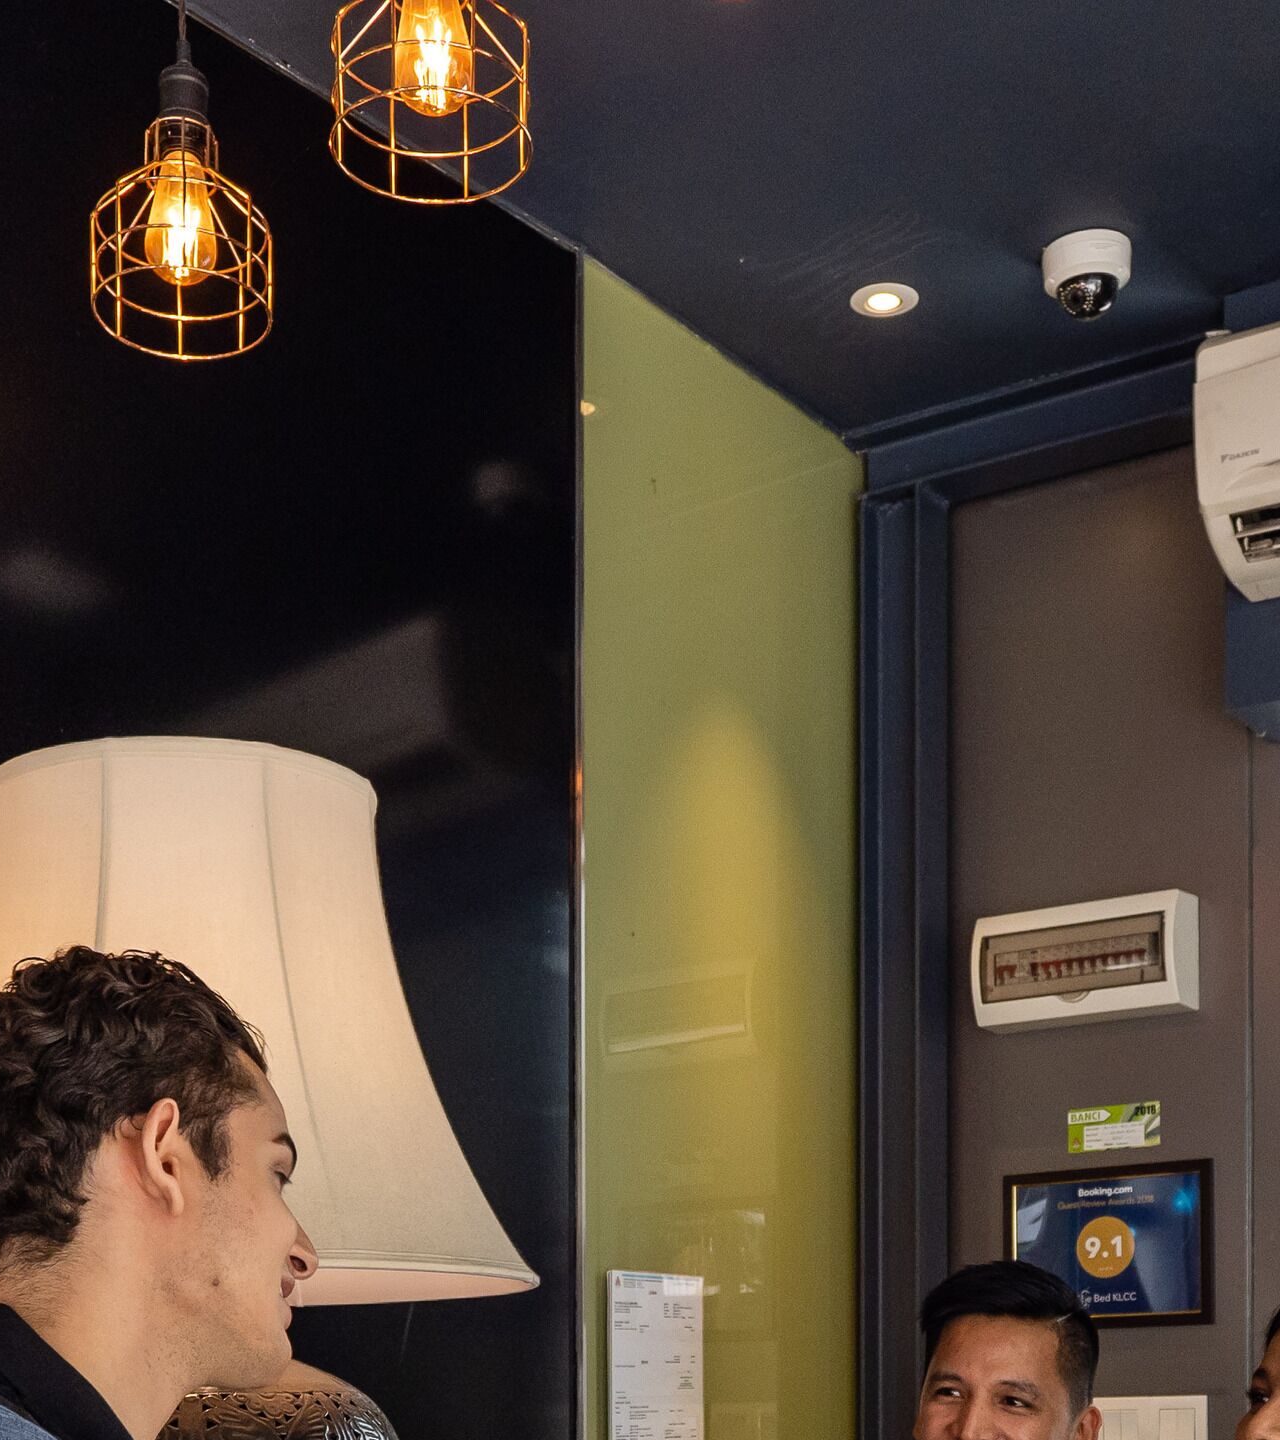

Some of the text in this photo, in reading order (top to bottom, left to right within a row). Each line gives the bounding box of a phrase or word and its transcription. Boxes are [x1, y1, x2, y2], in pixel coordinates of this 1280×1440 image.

[1070, 1111, 1101, 1123] BANCI
[1077, 1185, 1133, 1198] Booking.com
[1084, 1235, 1124, 1259] 9.1
[1112, 1291, 1137, 1302] KLCC
